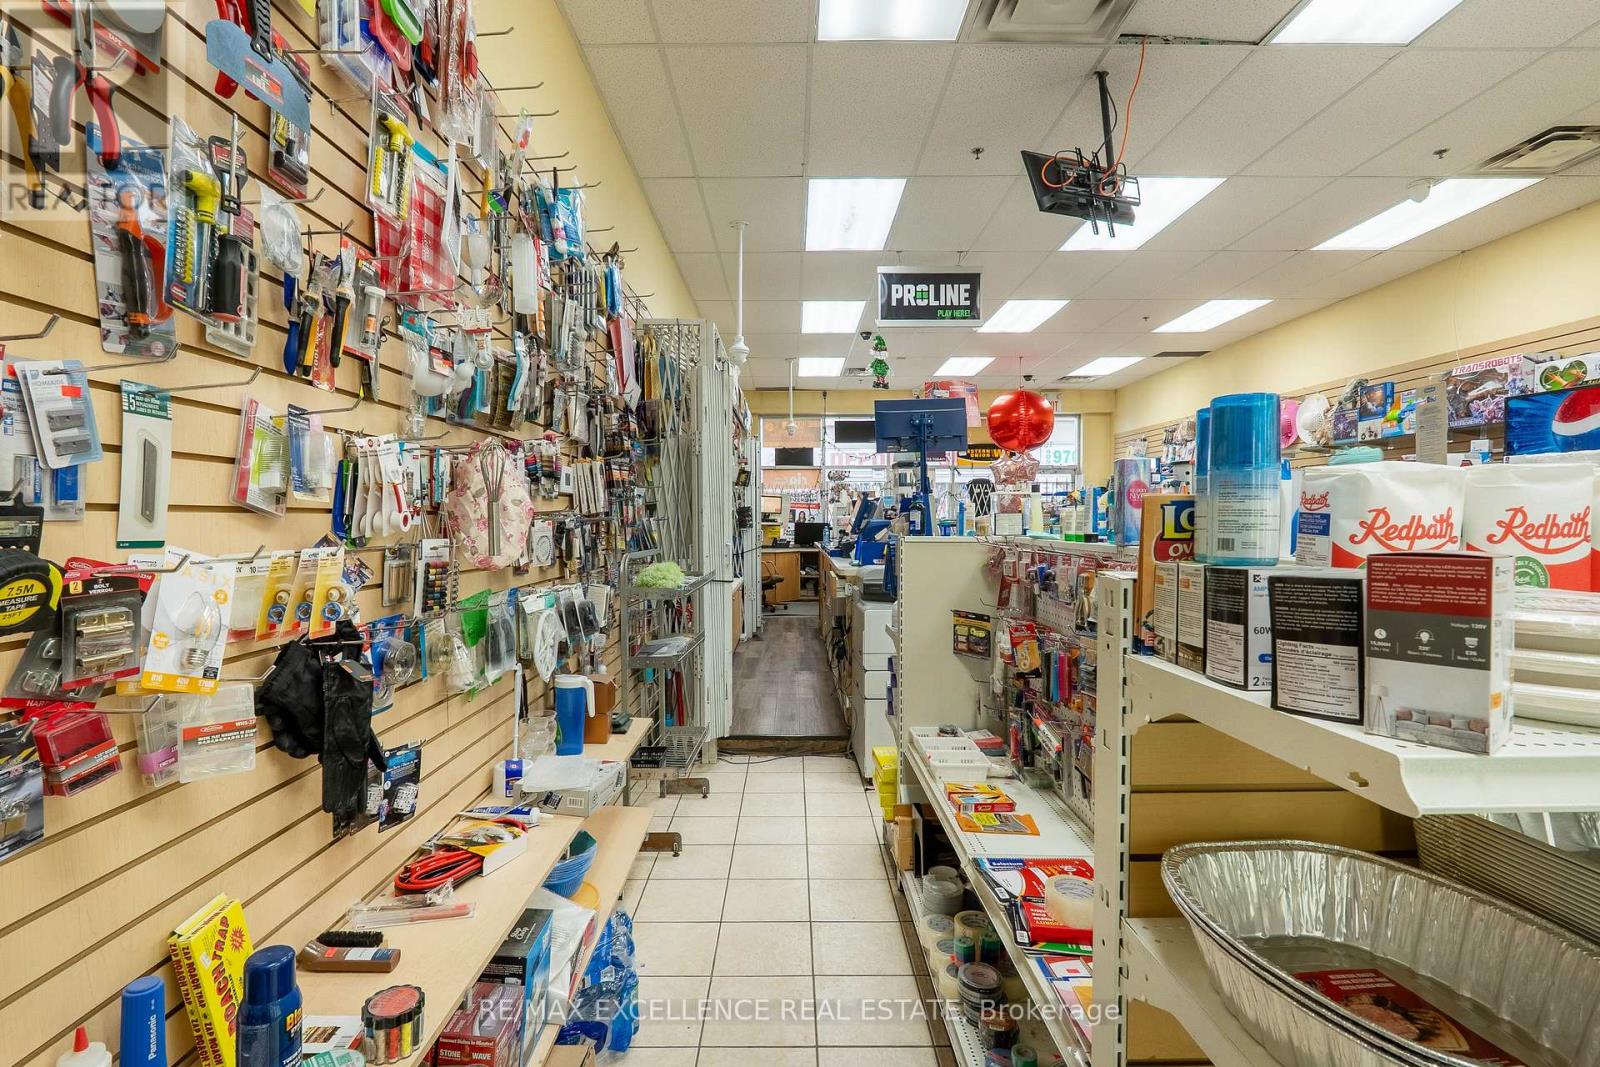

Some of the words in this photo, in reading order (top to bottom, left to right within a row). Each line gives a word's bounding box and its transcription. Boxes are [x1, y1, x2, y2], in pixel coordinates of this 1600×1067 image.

[891, 284, 970, 306] PROLINE
[1455, 355, 1523, 374] TRANSROBOTS
[129, 394, 136, 411] 5
[1349, 506, 1458, 551] Redpath
[1486, 505, 1592, 555] Redpath
[8, 584, 34, 597] 7.5M
[6, 603, 27, 612] TAPE
[169, 943, 178, 957] ZAP
[212, 915, 229, 961] TRAP
[173, 958, 187, 988] ROACH
[181, 945, 192, 960] ZAP
[187, 960, 201, 989] ROACH
[196, 989, 206, 1009] TRAP
[148, 1014, 157, 1061] Panasonic
[204, 1022, 214, 1038] ZAP
[209, 1037, 223, 1066] ROACH
[440, 1048, 461, 1058] STONE
[472, 1052, 492, 1060] WAVE
